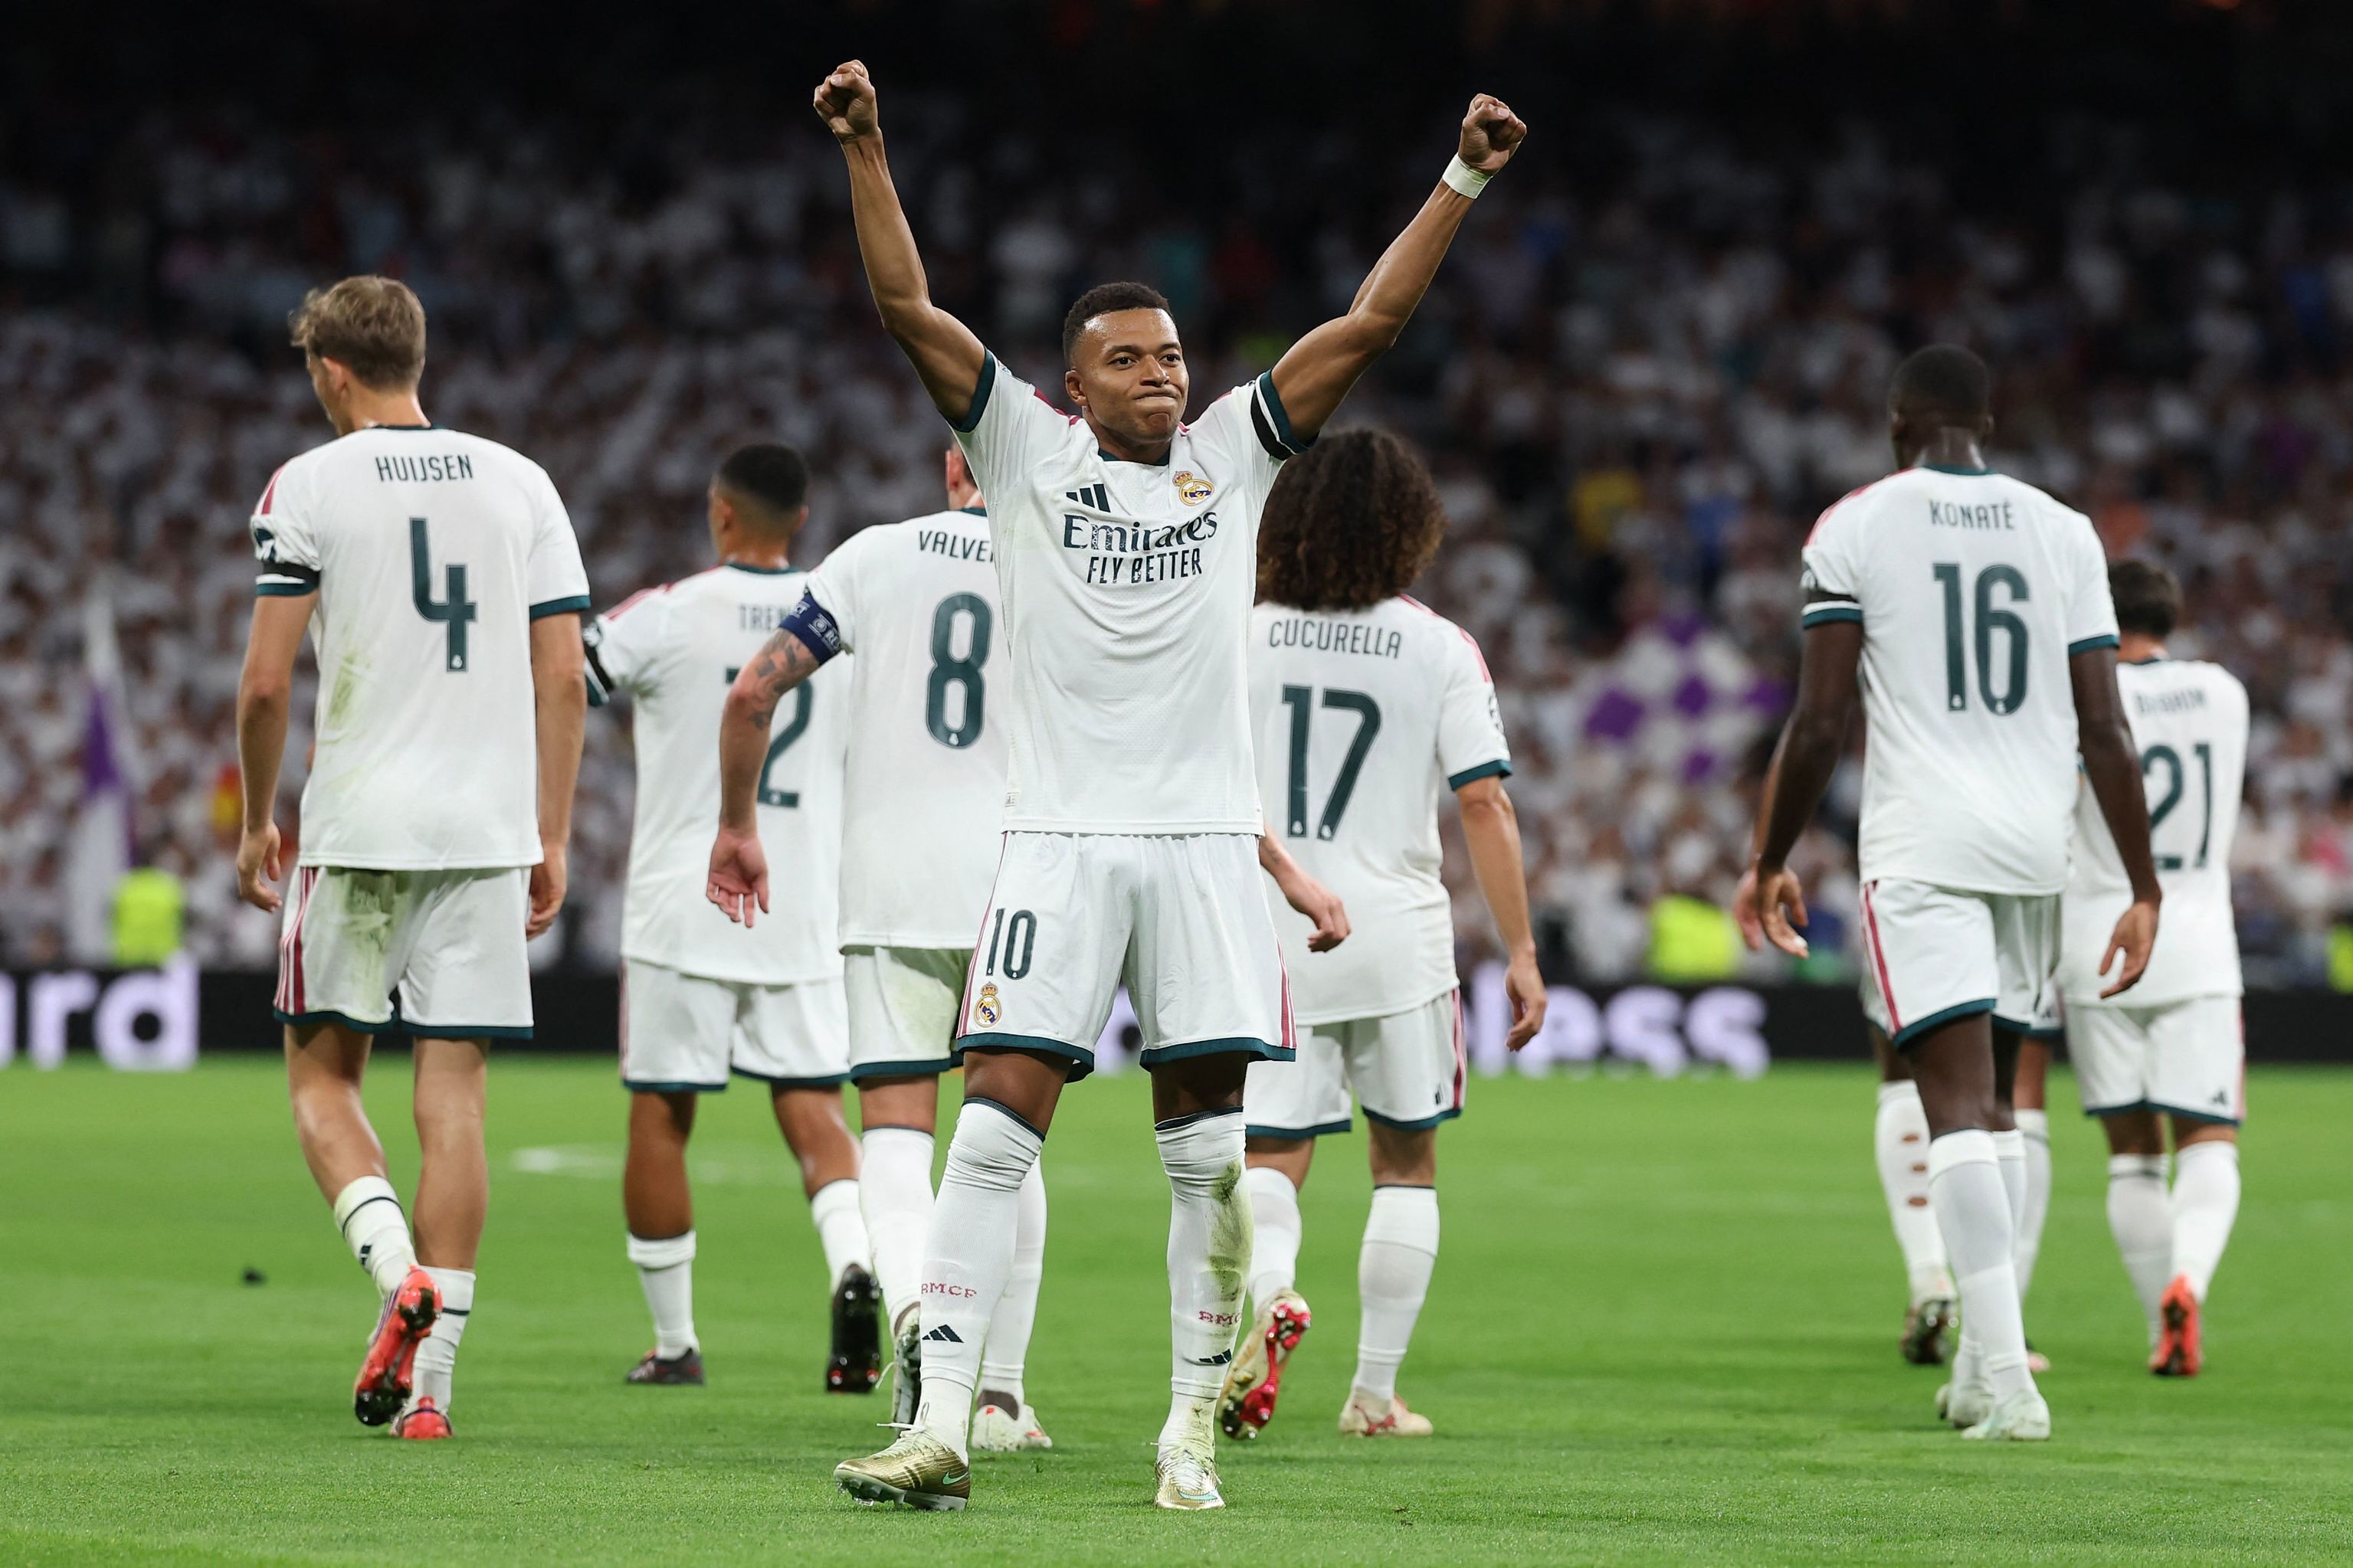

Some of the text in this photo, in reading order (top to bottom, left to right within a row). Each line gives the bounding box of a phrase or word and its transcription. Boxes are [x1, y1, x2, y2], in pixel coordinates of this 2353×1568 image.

[375, 455, 474, 482] HUIJSEN
[1929, 499, 2015, 530] KONATÉ
[1063, 512, 1218, 553] Emirates
[1086, 548, 1202, 584] FLY BETTER
[409, 516, 478, 672] 4
[1269, 619, 1402, 660] CUCURELLA
[1932, 563, 2030, 715] 16
[926, 592, 994, 749] 8
[1282, 683, 1382, 842] 17
[2142, 743, 2212, 870] 21
[985, 907, 1037, 980] 10
[1465, 961, 1771, 1080] less
